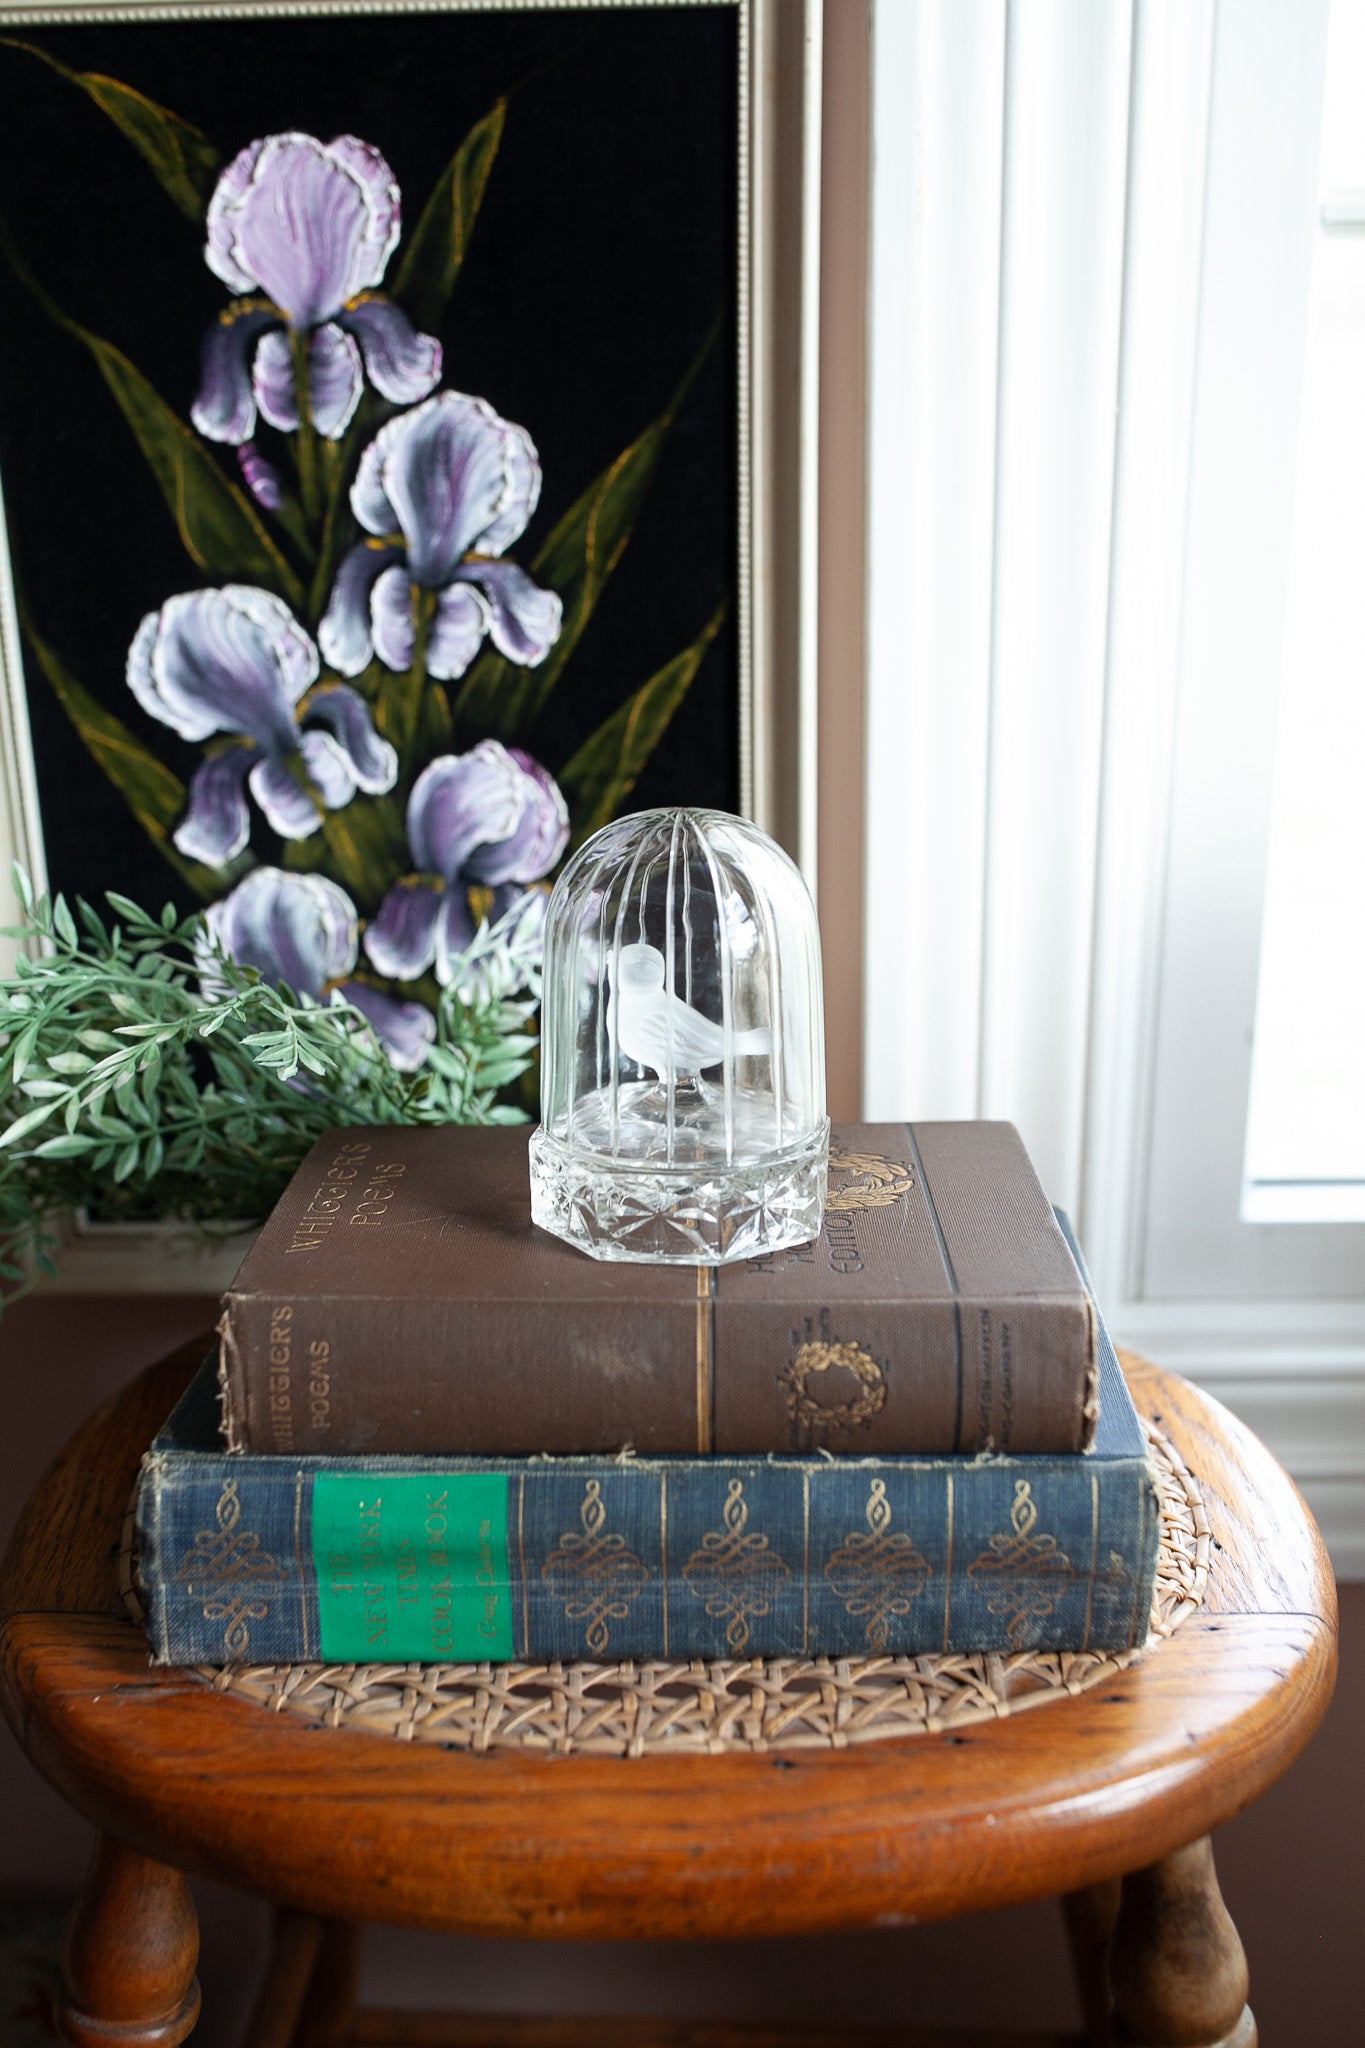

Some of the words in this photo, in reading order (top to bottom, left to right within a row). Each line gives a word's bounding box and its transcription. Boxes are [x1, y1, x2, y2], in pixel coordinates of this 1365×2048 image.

[349, 1162, 407, 1227] POEMS
[309, 1339, 332, 1430] POEMS
[359, 1497, 384, 1571] YORK
[425, 1490, 450, 1567] BOOK
[327, 1550, 353, 1597] THE
[396, 1538, 419, 1610] TIMES
[364, 1579, 389, 1645] NEW
[430, 1576, 454, 1653] COOK
